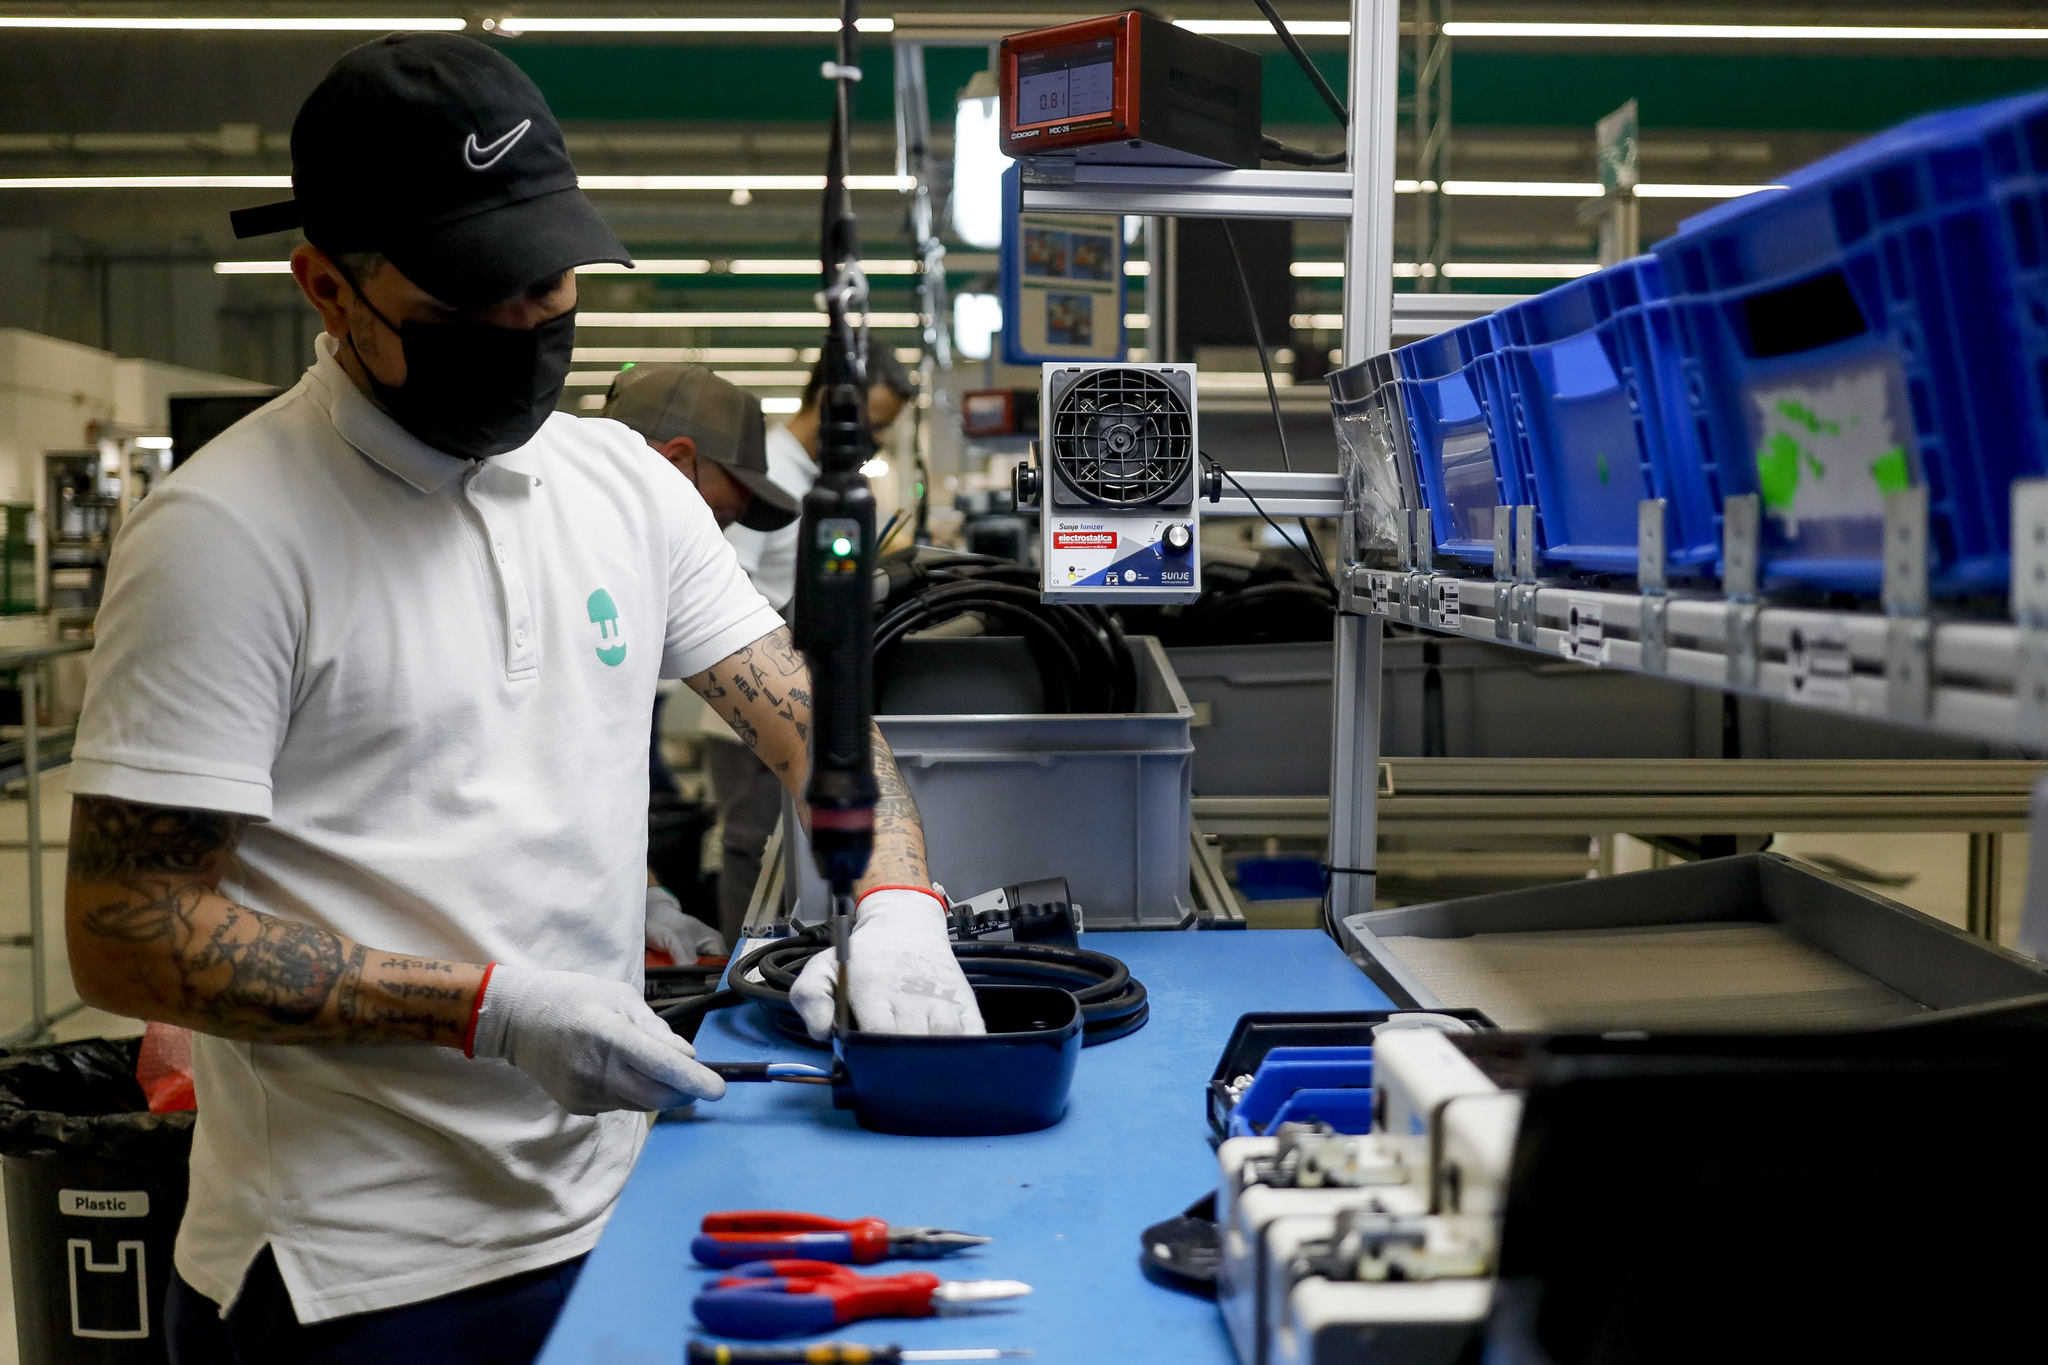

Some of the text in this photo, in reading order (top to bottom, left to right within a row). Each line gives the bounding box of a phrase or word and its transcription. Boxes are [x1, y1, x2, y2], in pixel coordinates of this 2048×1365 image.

[1040, 92, 1065, 110] 0.81
[1059, 523, 1079, 531] Sunje
[1161, 571, 1190, 580] SUNJE
[75, 1196, 127, 1211] Plastic
